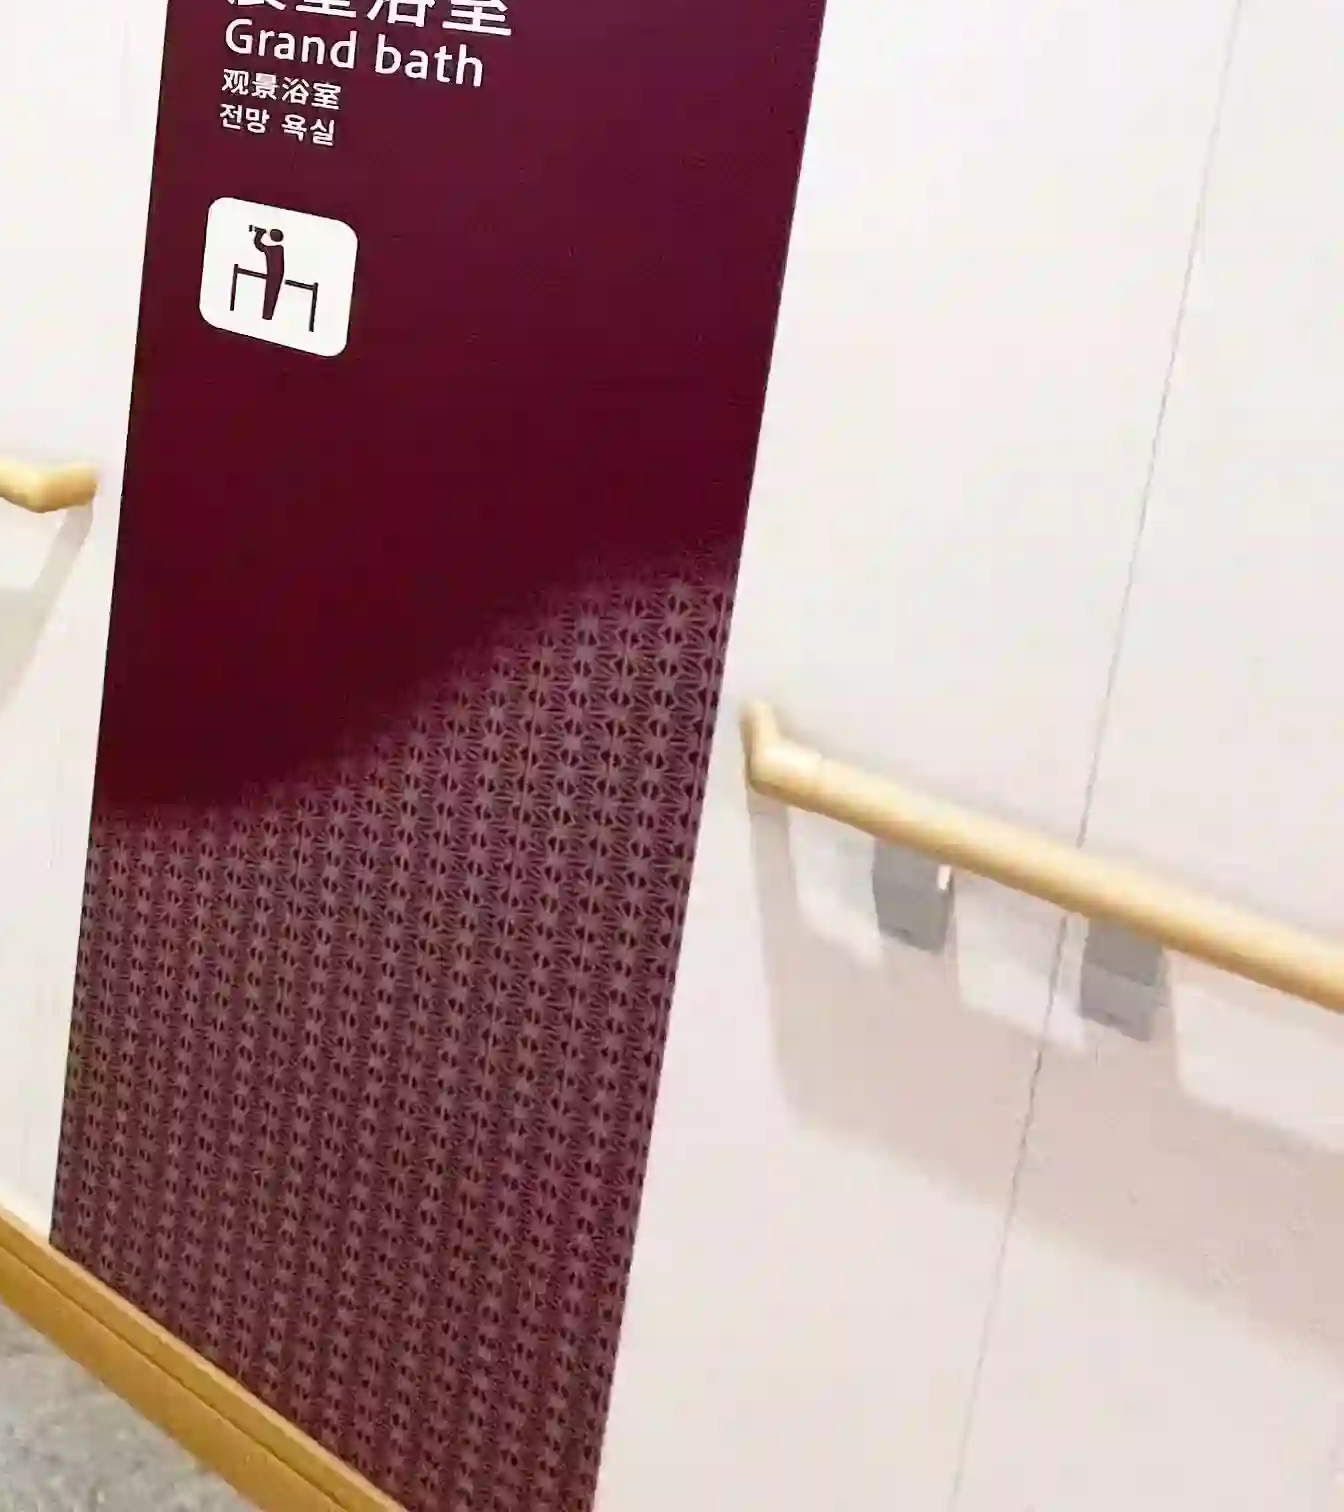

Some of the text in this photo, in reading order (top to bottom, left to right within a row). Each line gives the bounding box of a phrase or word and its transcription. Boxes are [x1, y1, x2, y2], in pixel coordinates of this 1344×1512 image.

[224, 18, 483, 87] Grand bath
[221, 68, 342, 110] 观景浴室
[219, 103, 336, 146] 전망 욕실
